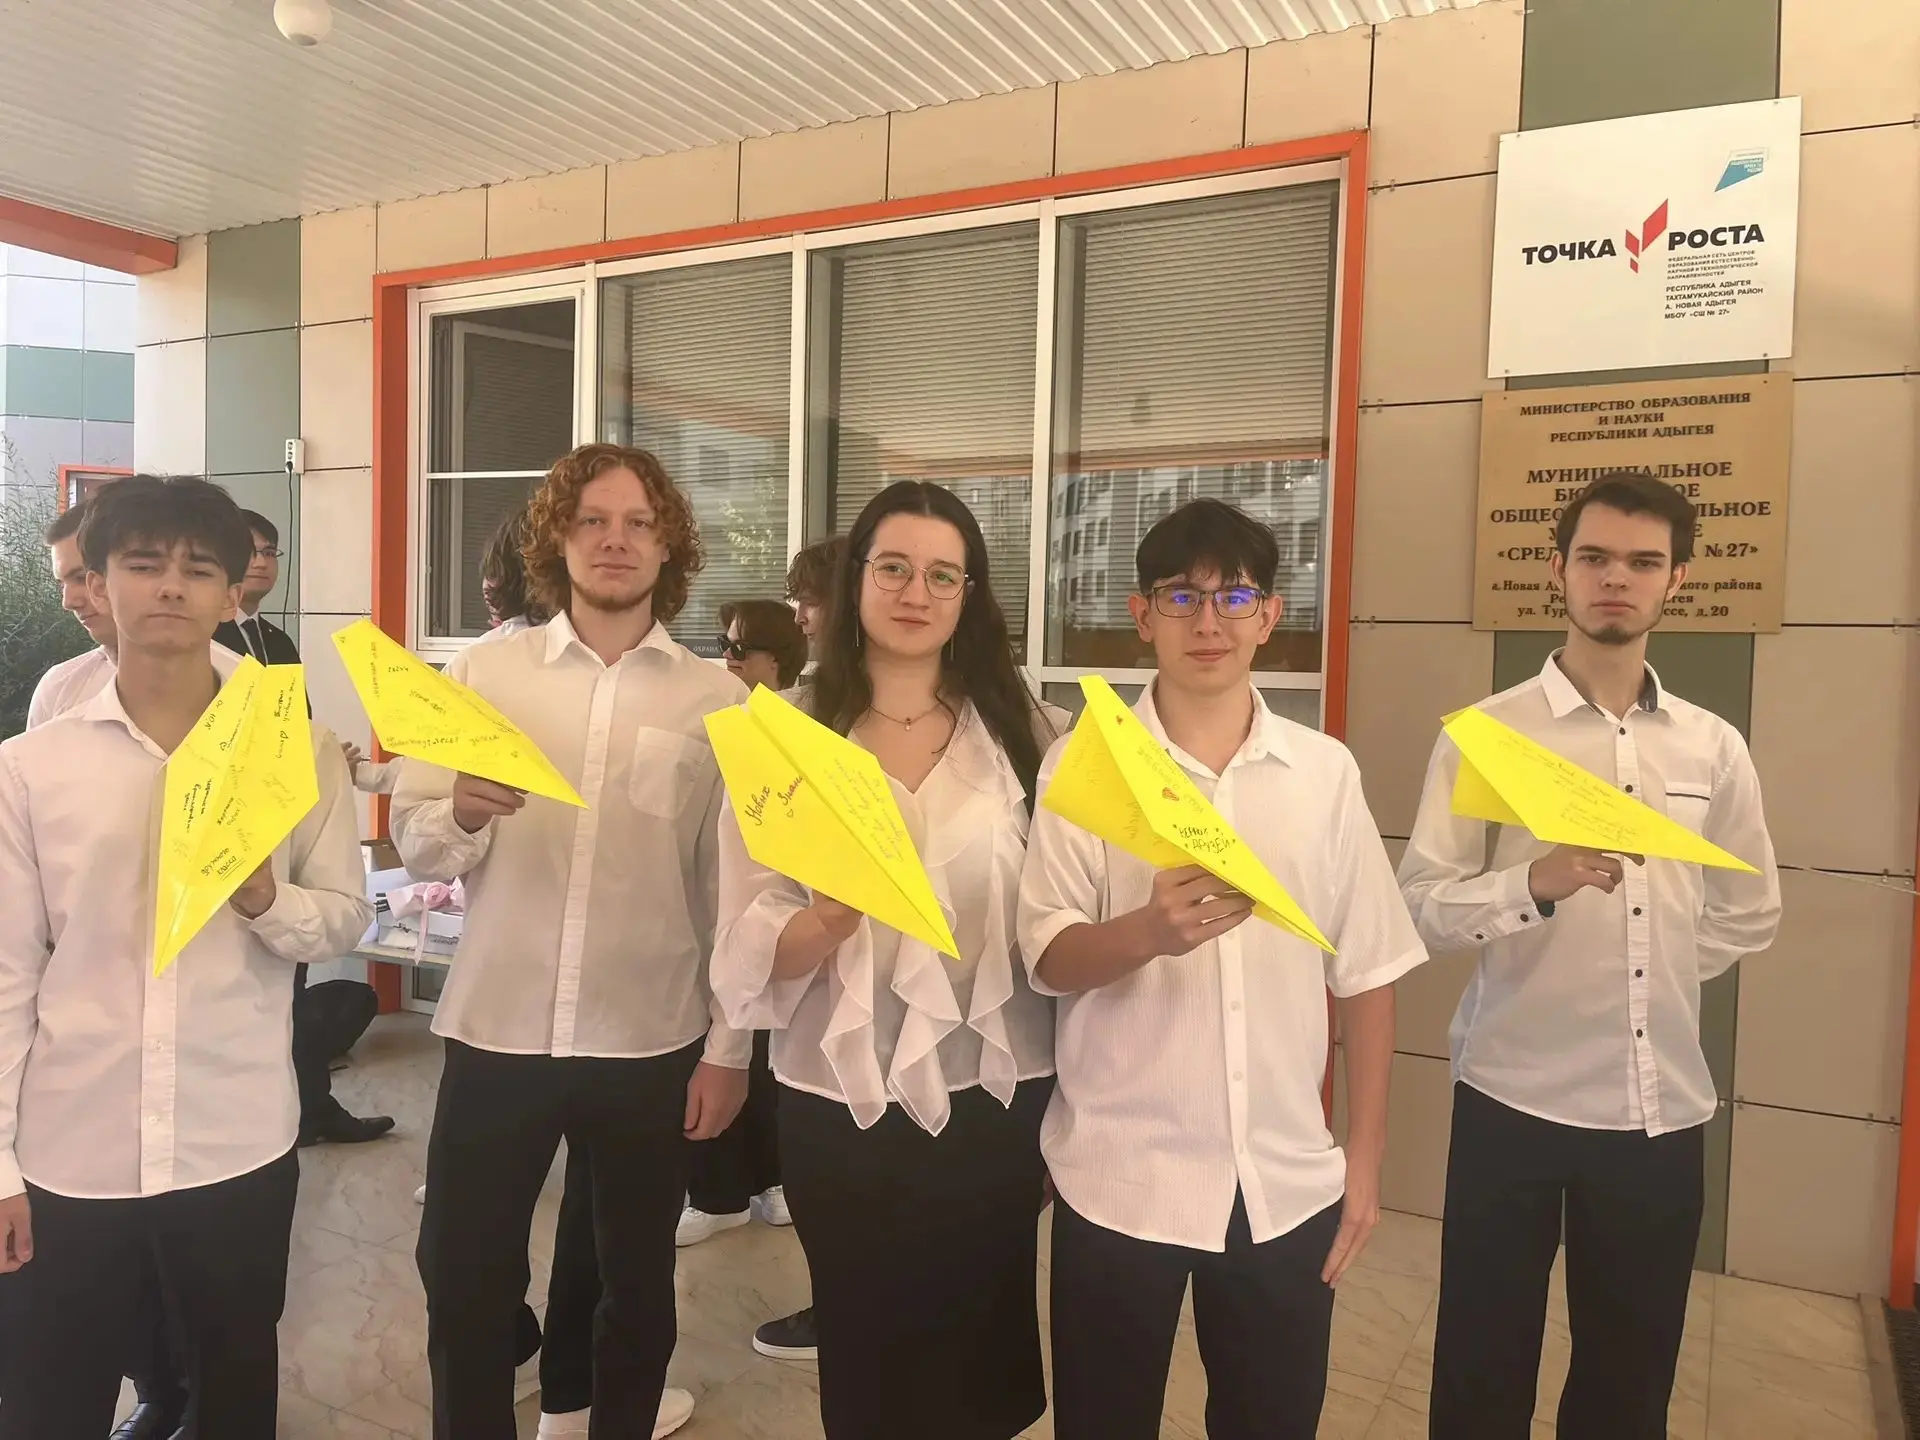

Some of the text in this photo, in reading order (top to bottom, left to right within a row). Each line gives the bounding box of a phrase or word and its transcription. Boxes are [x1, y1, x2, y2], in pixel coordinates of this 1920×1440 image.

[1521, 223, 1765, 265] ТОЧКА РОСТА
[1668, 253, 1710, 262] ФЕДЕРАЛЬНАЯ
[1728, 249, 1755, 257] ЦЕНТРОВ
[1668, 260, 1710, 268] ОБРАЗОВАНИЯ
[1700, 261, 1759, 271] ТЕХНОЛОГИЧЕСКОЙ
[1667, 270, 1725, 280] НАПРАВЛЕННОСТЕЙ
[1665, 279, 1751, 292] РЕСПУБЛИКА АДЫГЕЯ
[1665, 287, 1763, 301] ТАХТАМУКАЙСКИЙ РАЙОН
[1675, 301, 1702, 309] НОВАЯ
[1705, 298, 1737, 307] АДЫГЕЯ
[1519, 392, 1751, 417] МИНИСТЕРСТВО ОБРАЗОВАНИЯ
[1598, 412, 1665, 425] И НАУКИ
[1550, 424, 1715, 443] РЕСПУБЛИКИ АДЫГЕЯ
[1714, 578, 1763, 593] района
[1517, 607, 1536, 617] ул.
